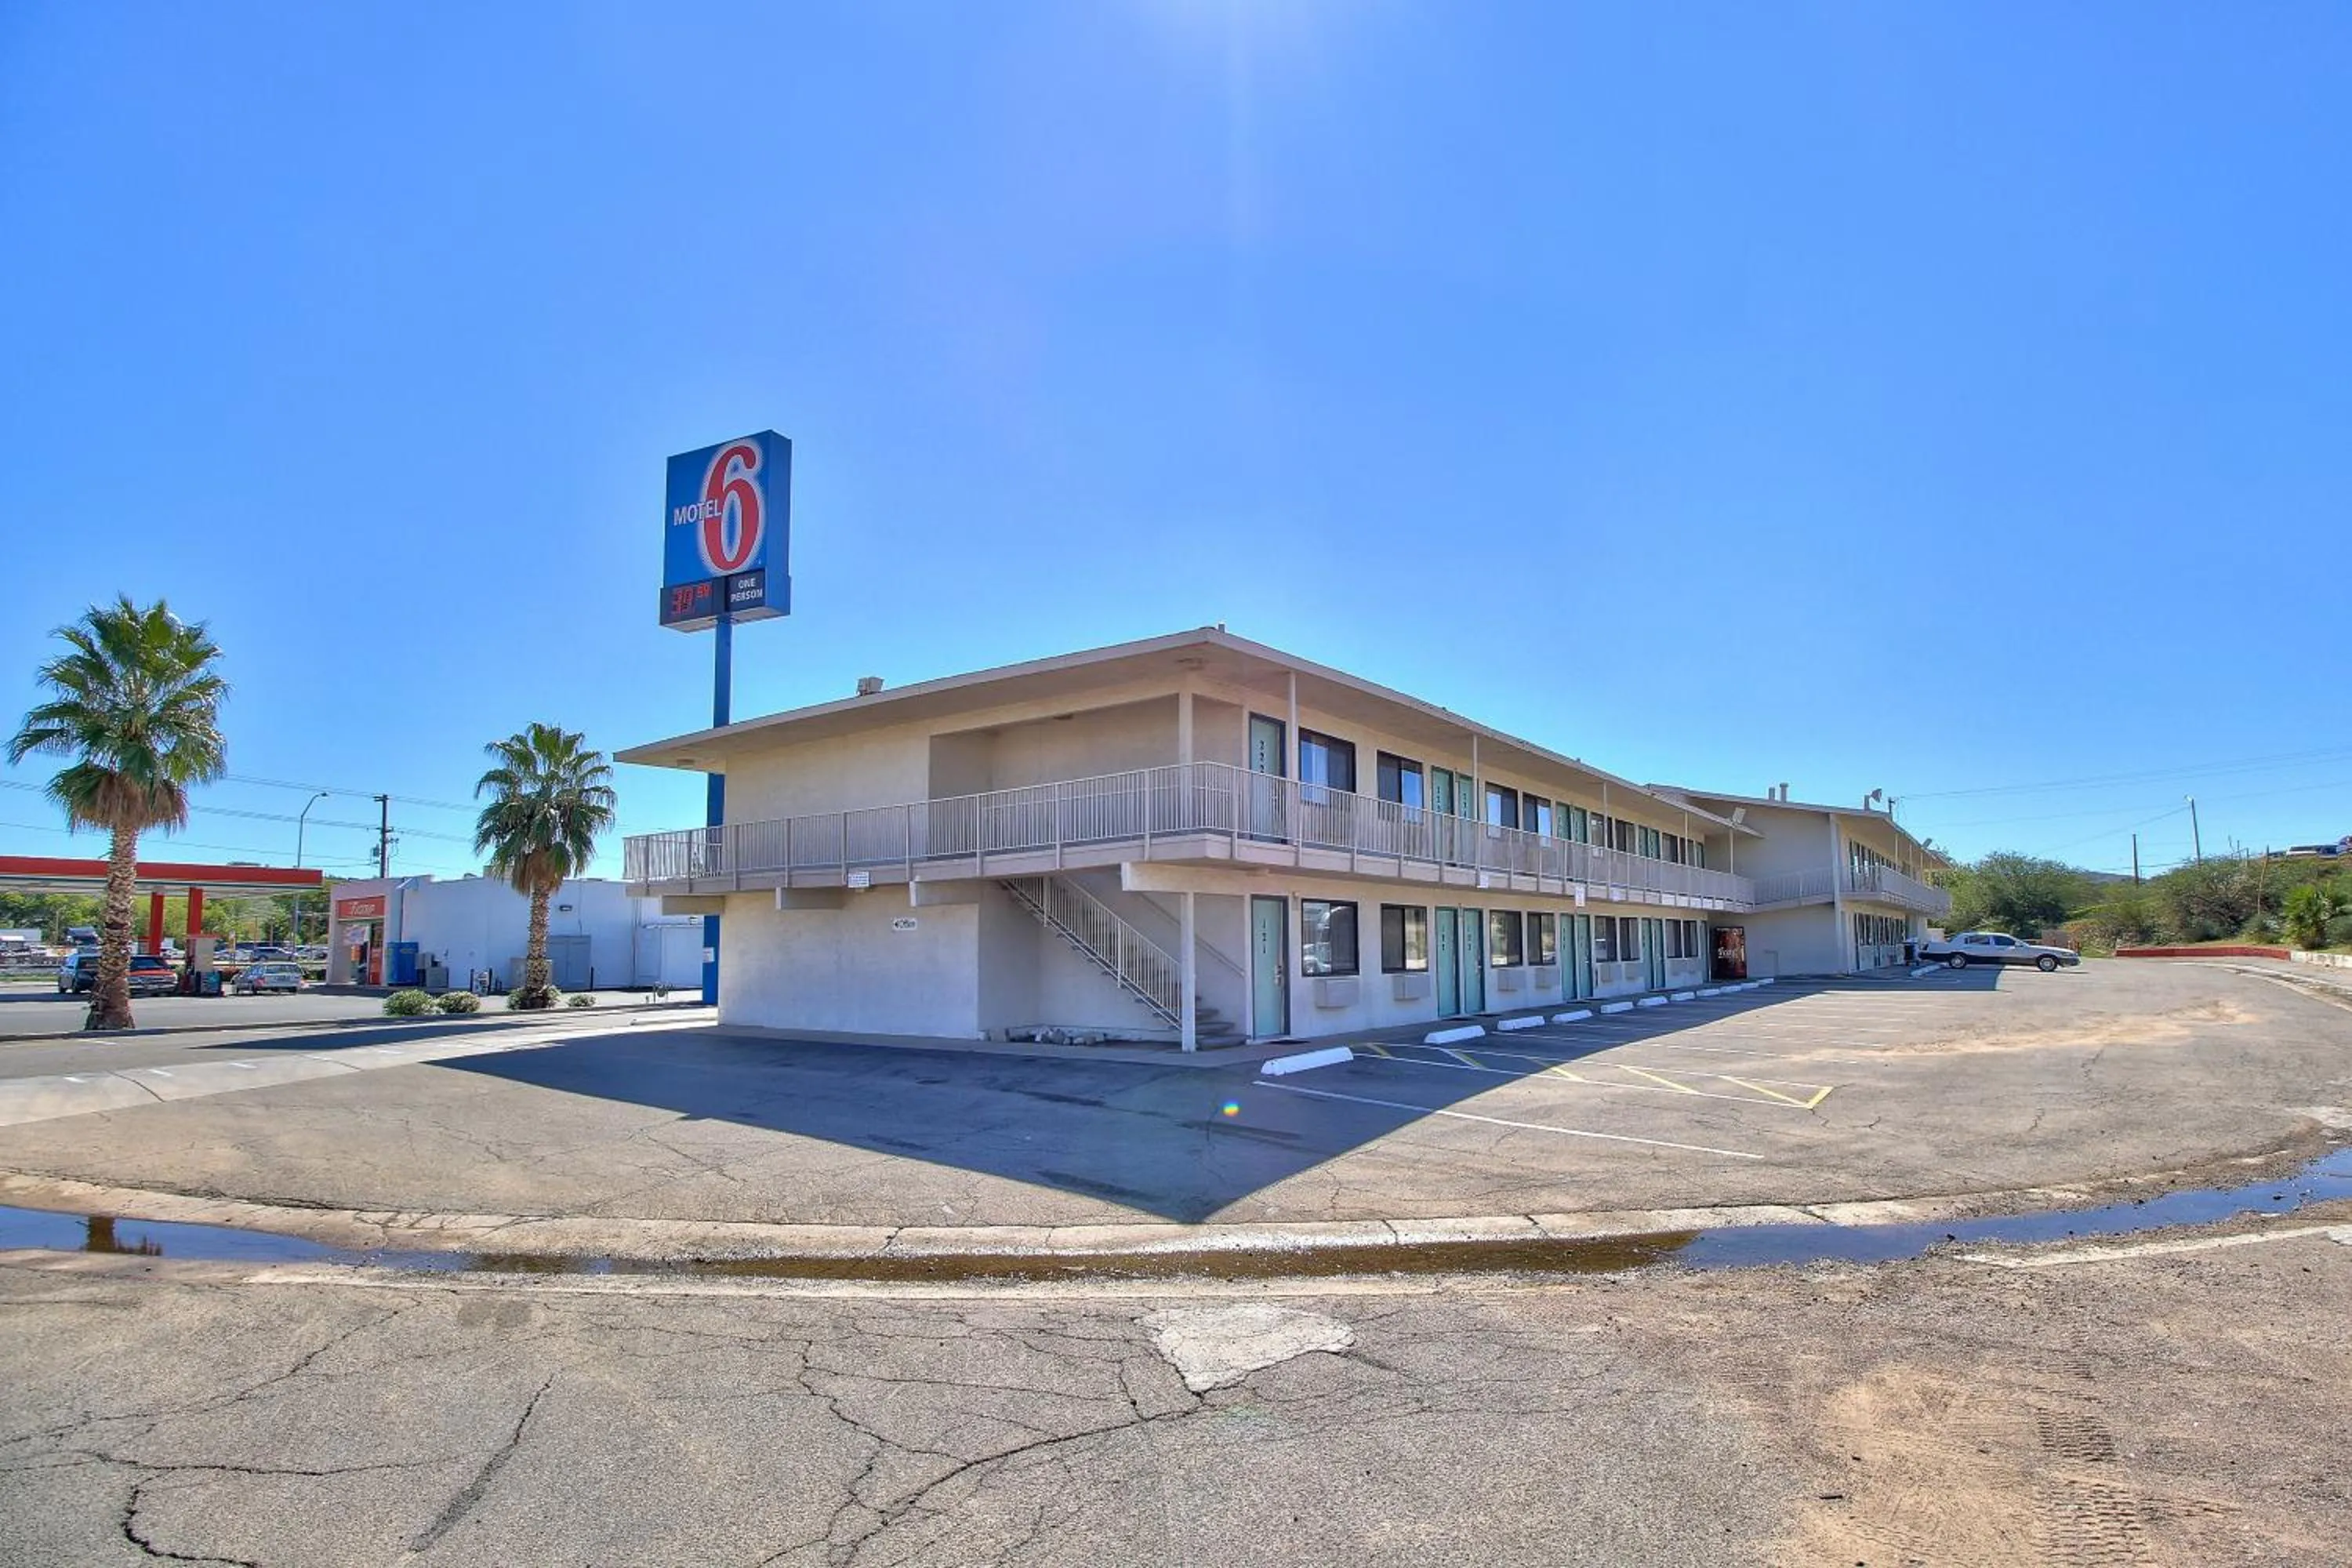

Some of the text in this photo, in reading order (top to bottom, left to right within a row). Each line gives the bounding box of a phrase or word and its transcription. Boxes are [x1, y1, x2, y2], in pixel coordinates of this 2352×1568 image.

[673, 444, 760, 572] MOTEL 6
[738, 578, 757, 589] ONE
[730, 589, 763, 603] PERSON
